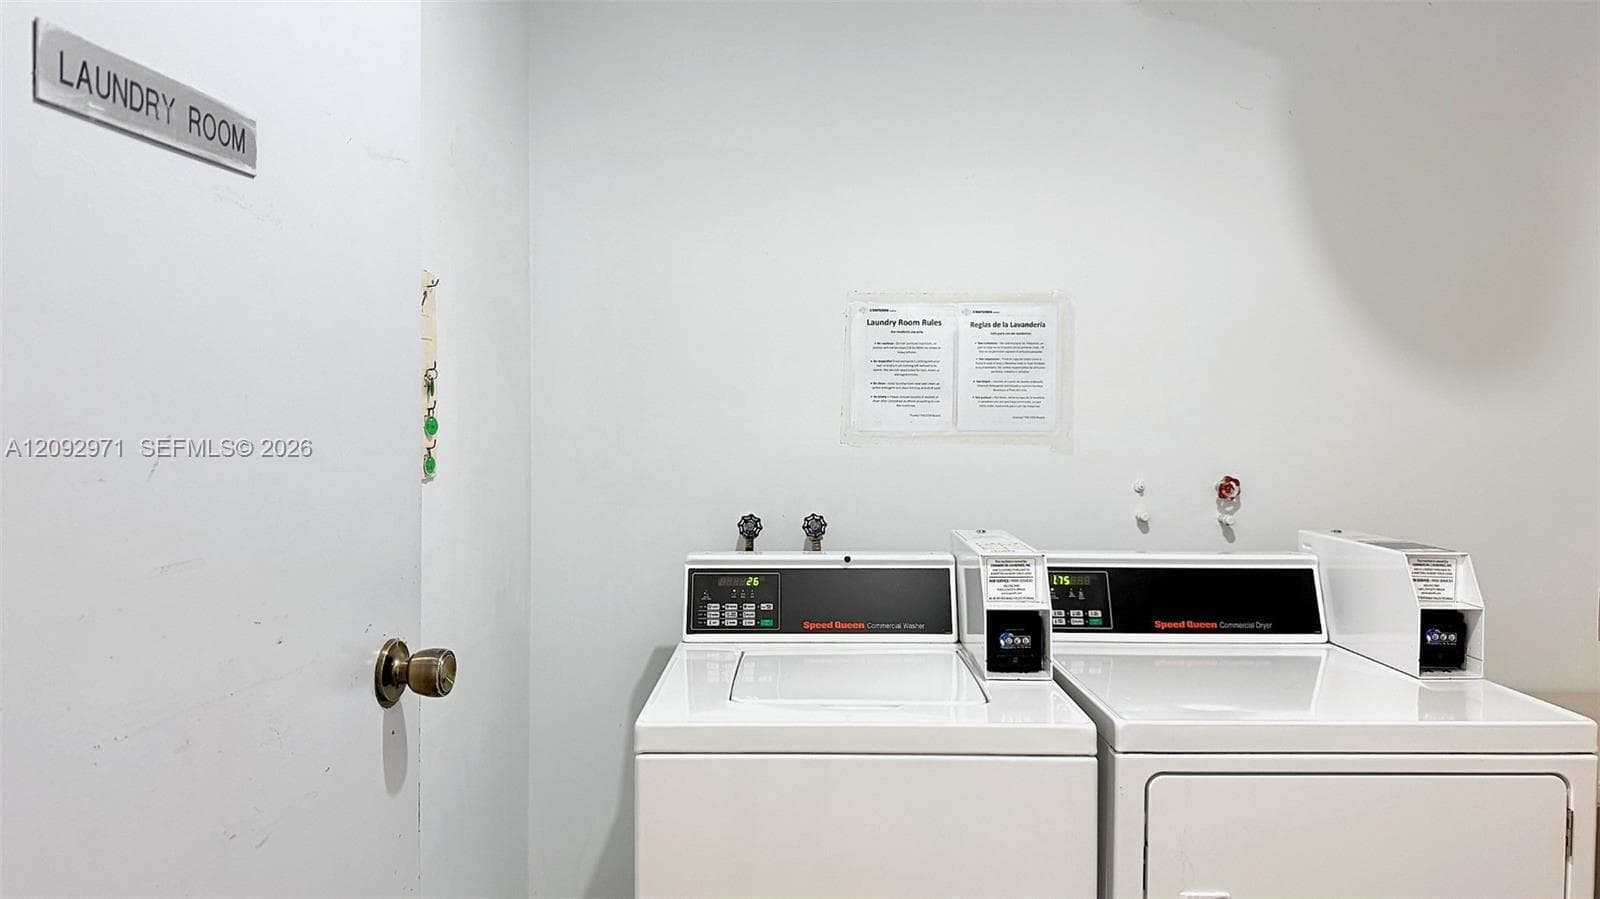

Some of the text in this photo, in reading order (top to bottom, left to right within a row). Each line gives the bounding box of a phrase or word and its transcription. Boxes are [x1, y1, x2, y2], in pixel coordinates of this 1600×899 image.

[58, 50, 246, 155] LAUNDRY ROOM
[866, 319, 942, 328] Laundry Room Rules
[970, 321, 992, 329] Reglas
[992, 321, 1002, 329] de
[746, 576, 760, 587] 26
[803, 620, 925, 630] Speed Queen Commercial Washer
[1154, 620, 1273, 631] Speed Queen Commercial Dryer
